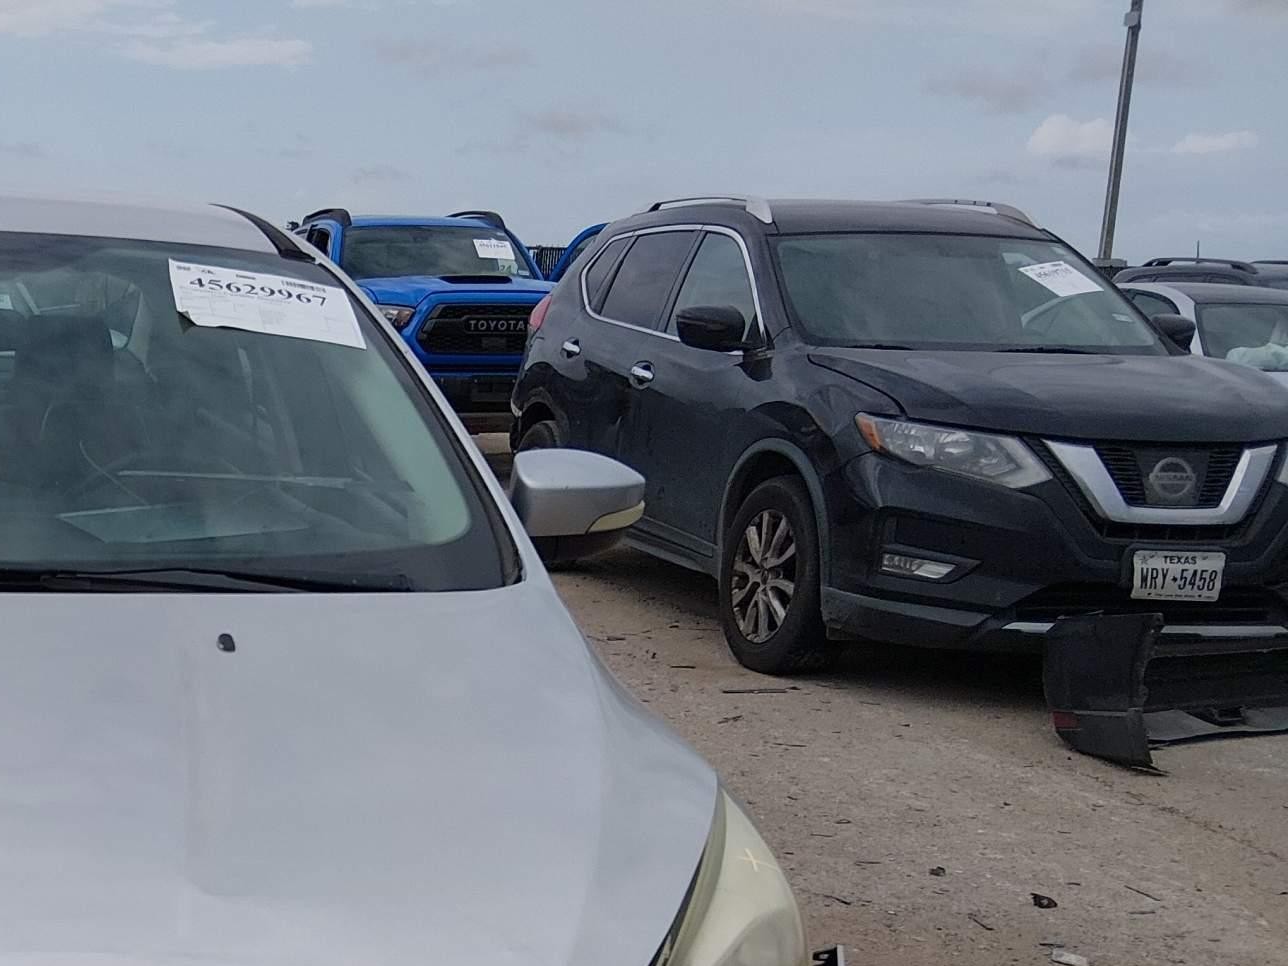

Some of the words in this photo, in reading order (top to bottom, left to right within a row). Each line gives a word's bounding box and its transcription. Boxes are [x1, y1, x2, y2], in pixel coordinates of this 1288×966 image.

[189, 276, 327, 307] 45629967
[468, 320, 527, 332] TOYOTA
[1163, 555, 1197, 566] TEXAS
